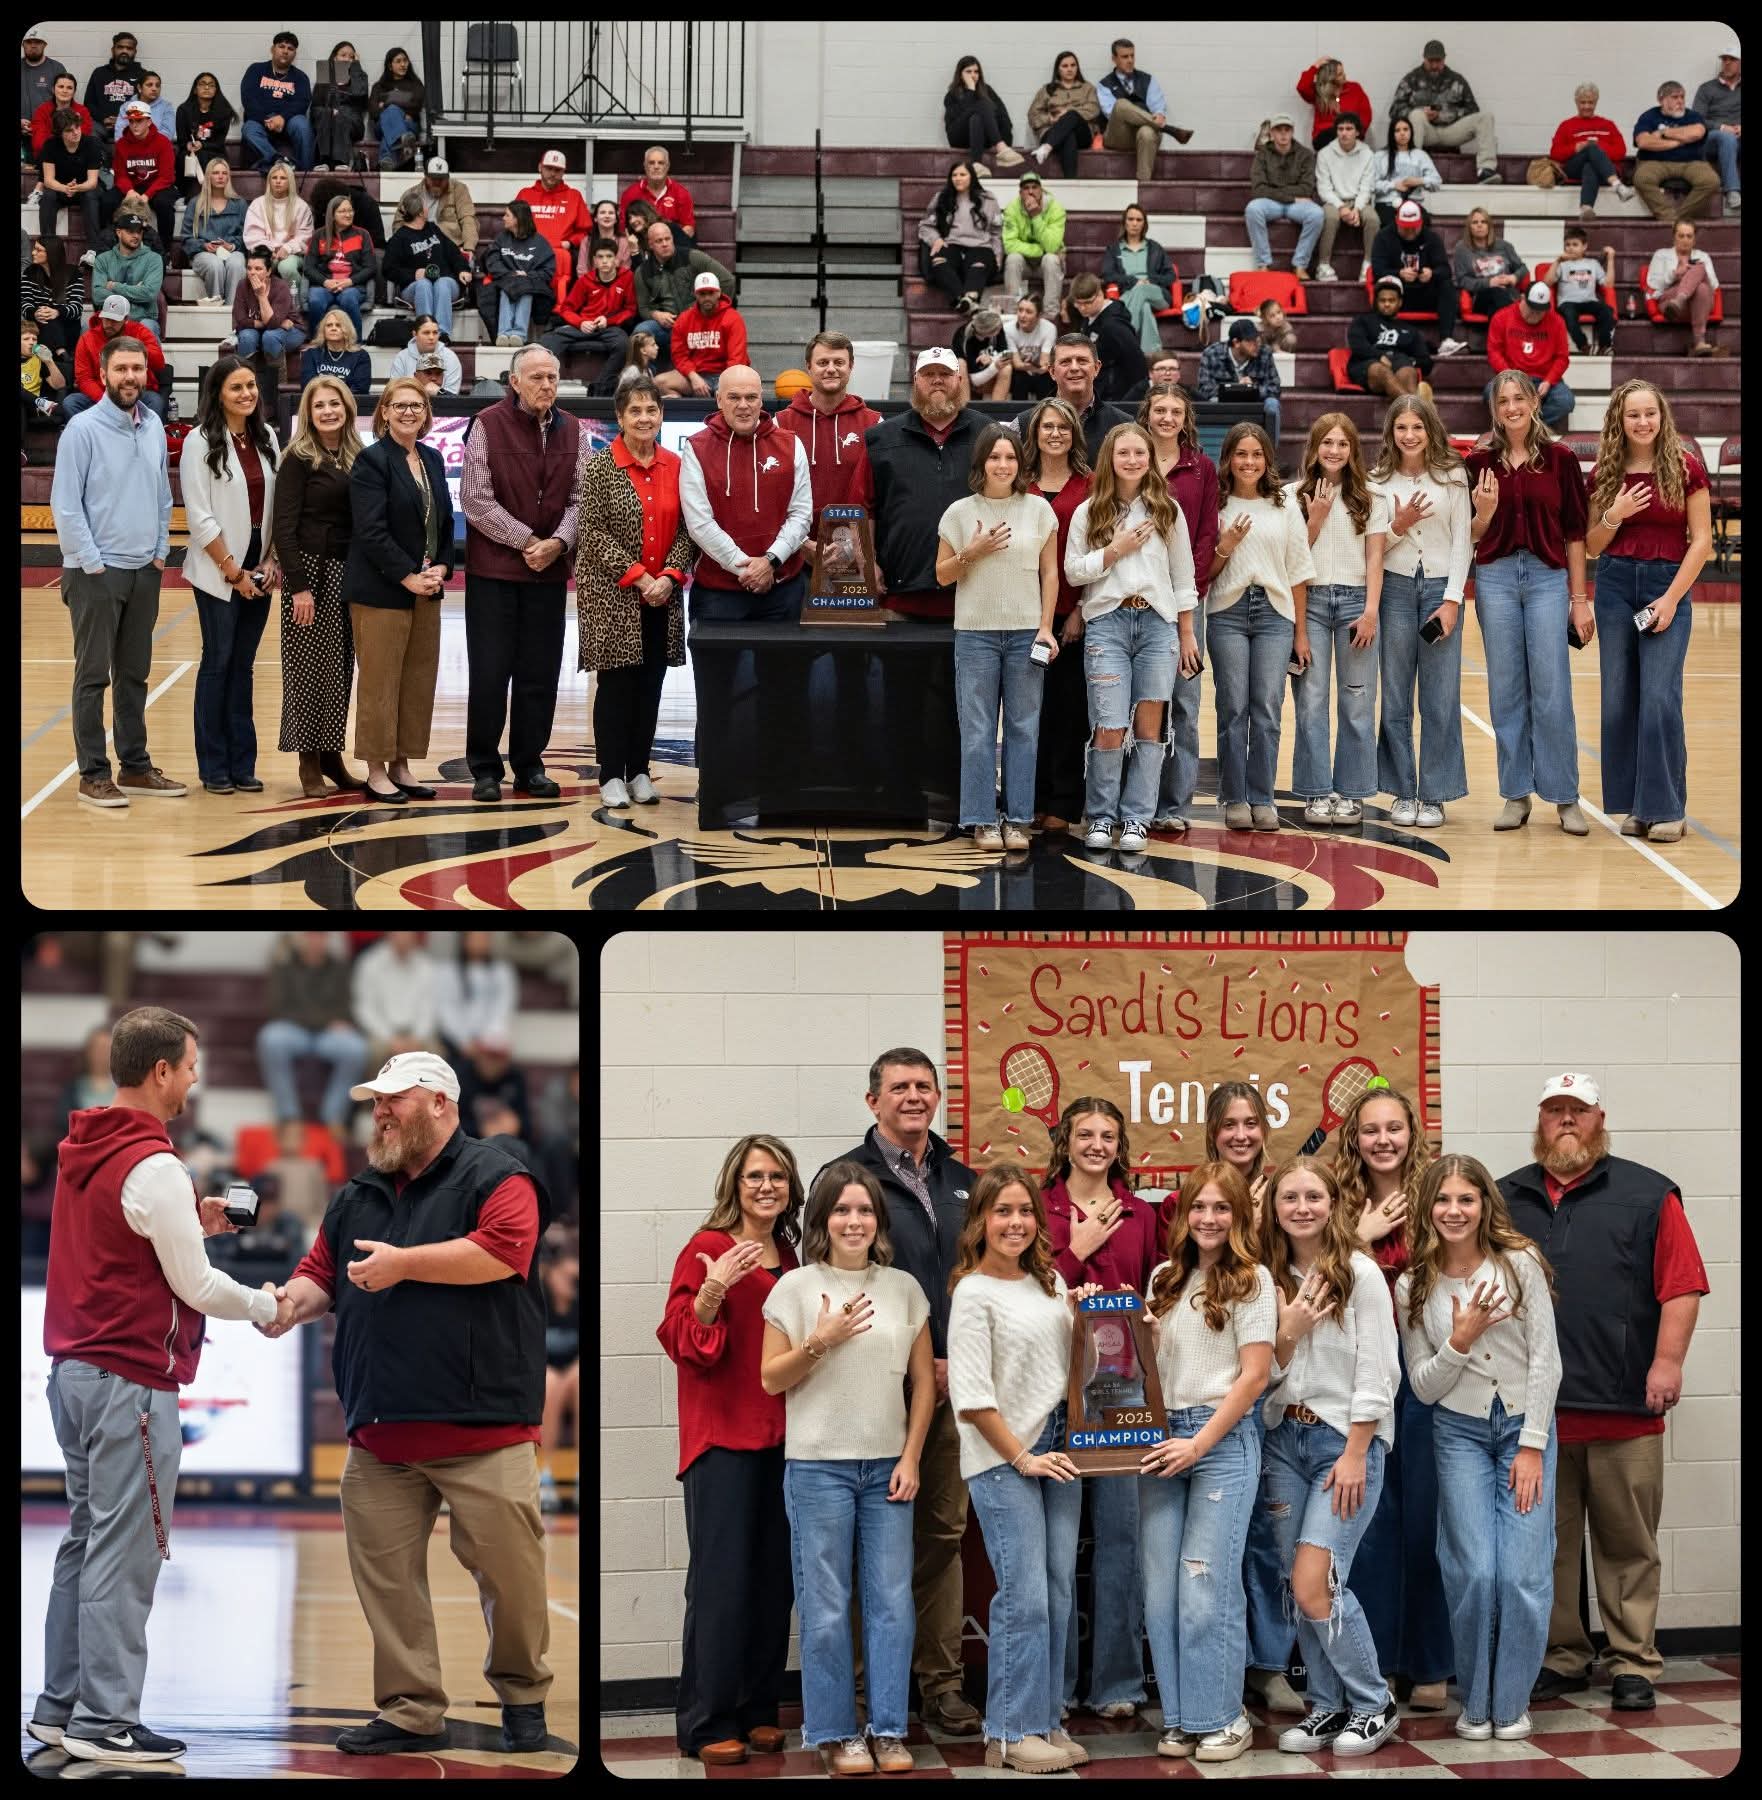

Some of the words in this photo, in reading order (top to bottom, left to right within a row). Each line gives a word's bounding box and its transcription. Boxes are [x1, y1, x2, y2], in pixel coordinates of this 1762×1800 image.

[317, 364, 351, 376] LONDON
[828, 509, 860, 517] STATE
[842, 586, 868, 594] 2025
[812, 598, 874, 606] CHAMPION
[1027, 964, 1202, 1041] Sardis
[1220, 975, 1360, 1049] Lions
[1560, 1075, 1575, 1088] S
[1088, 1296, 1134, 1309] STATE
[1116, 1412, 1153, 1425] 2025
[1072, 1430, 1164, 1446] CHAMPION
